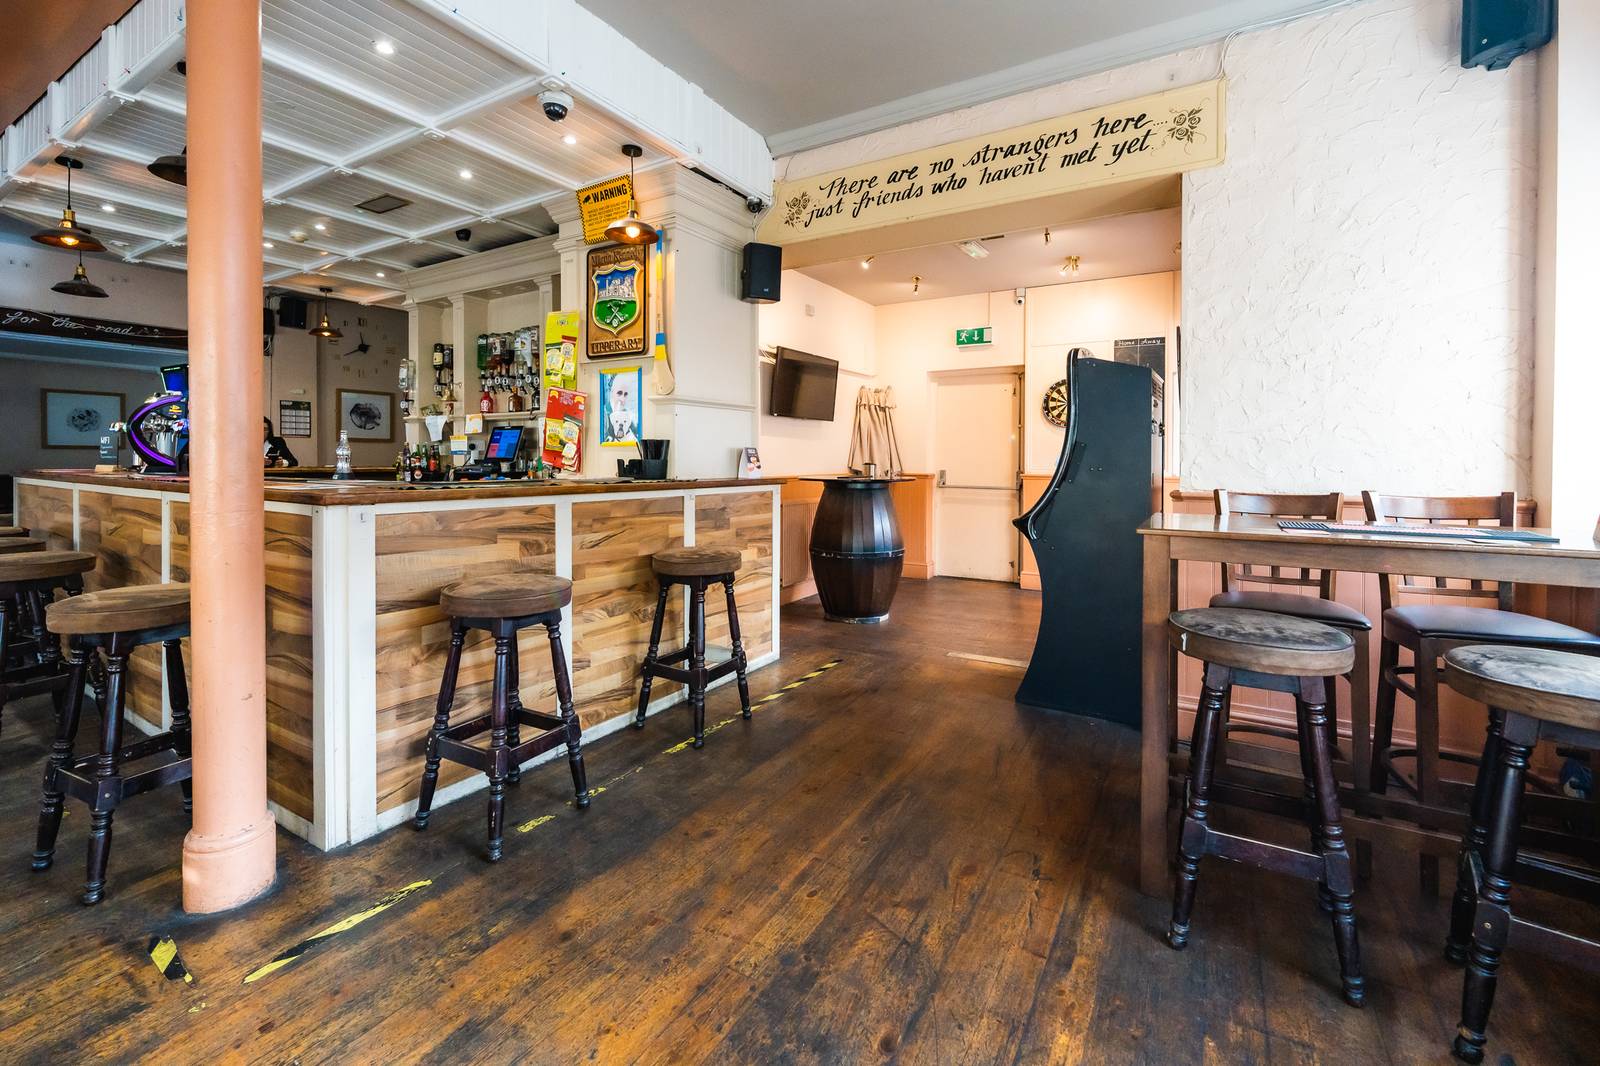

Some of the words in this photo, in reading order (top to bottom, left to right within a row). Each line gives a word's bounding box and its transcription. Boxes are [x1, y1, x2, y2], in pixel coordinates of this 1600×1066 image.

[804, 196, 844, 228] just
[852, 182, 924, 218] friends
[931, 172, 967, 195] who
[1060, 142, 1102, 169] met
[819, 175, 879, 198] There
[886, 165, 919, 184] are
[929, 157, 954, 176] no
[962, 127, 1079, 167] strangers
[591, 183, 628, 203] WARNING
[1, 311, 41, 325] for
